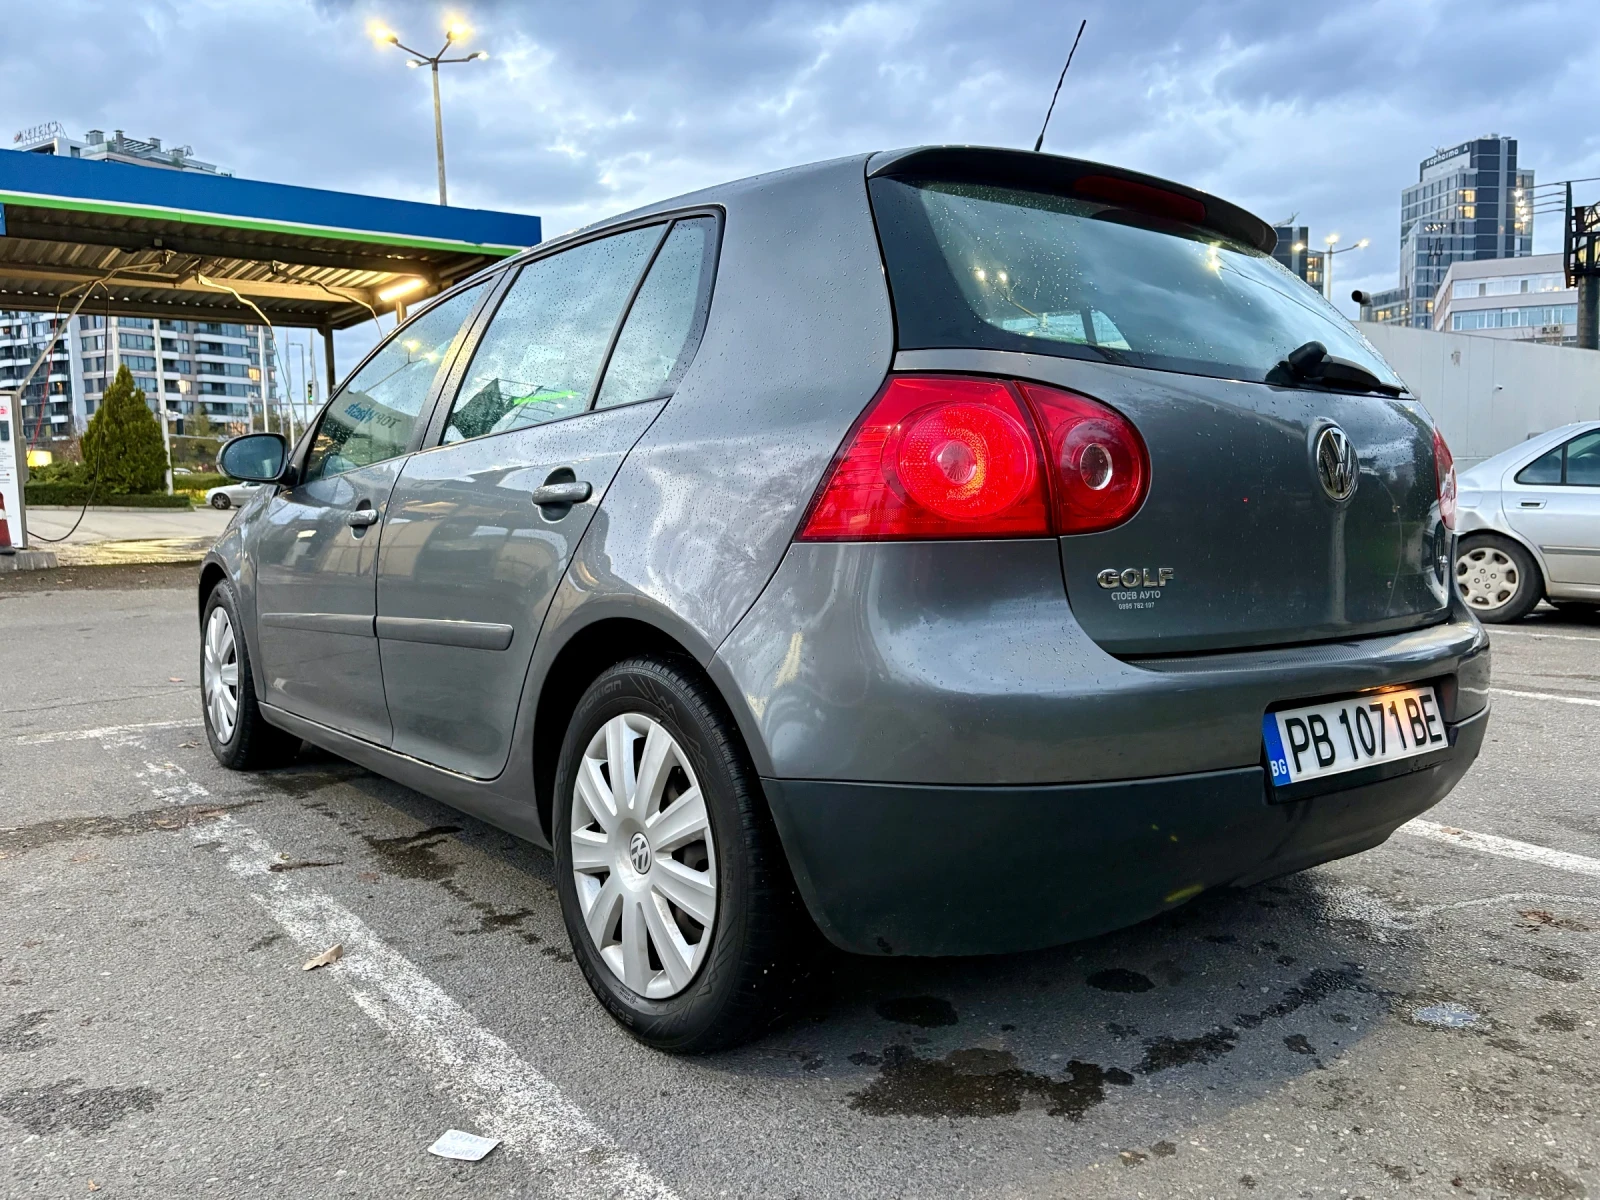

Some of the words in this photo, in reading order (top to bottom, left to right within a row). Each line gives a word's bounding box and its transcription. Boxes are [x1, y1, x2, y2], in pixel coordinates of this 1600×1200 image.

[1097, 567, 1174, 589] GOLF
[1285, 713, 1336, 774] PB
[1338, 700, 1407, 760] 1071
[1405, 695, 1443, 747] BE
[1270, 760, 1288, 777] BG
